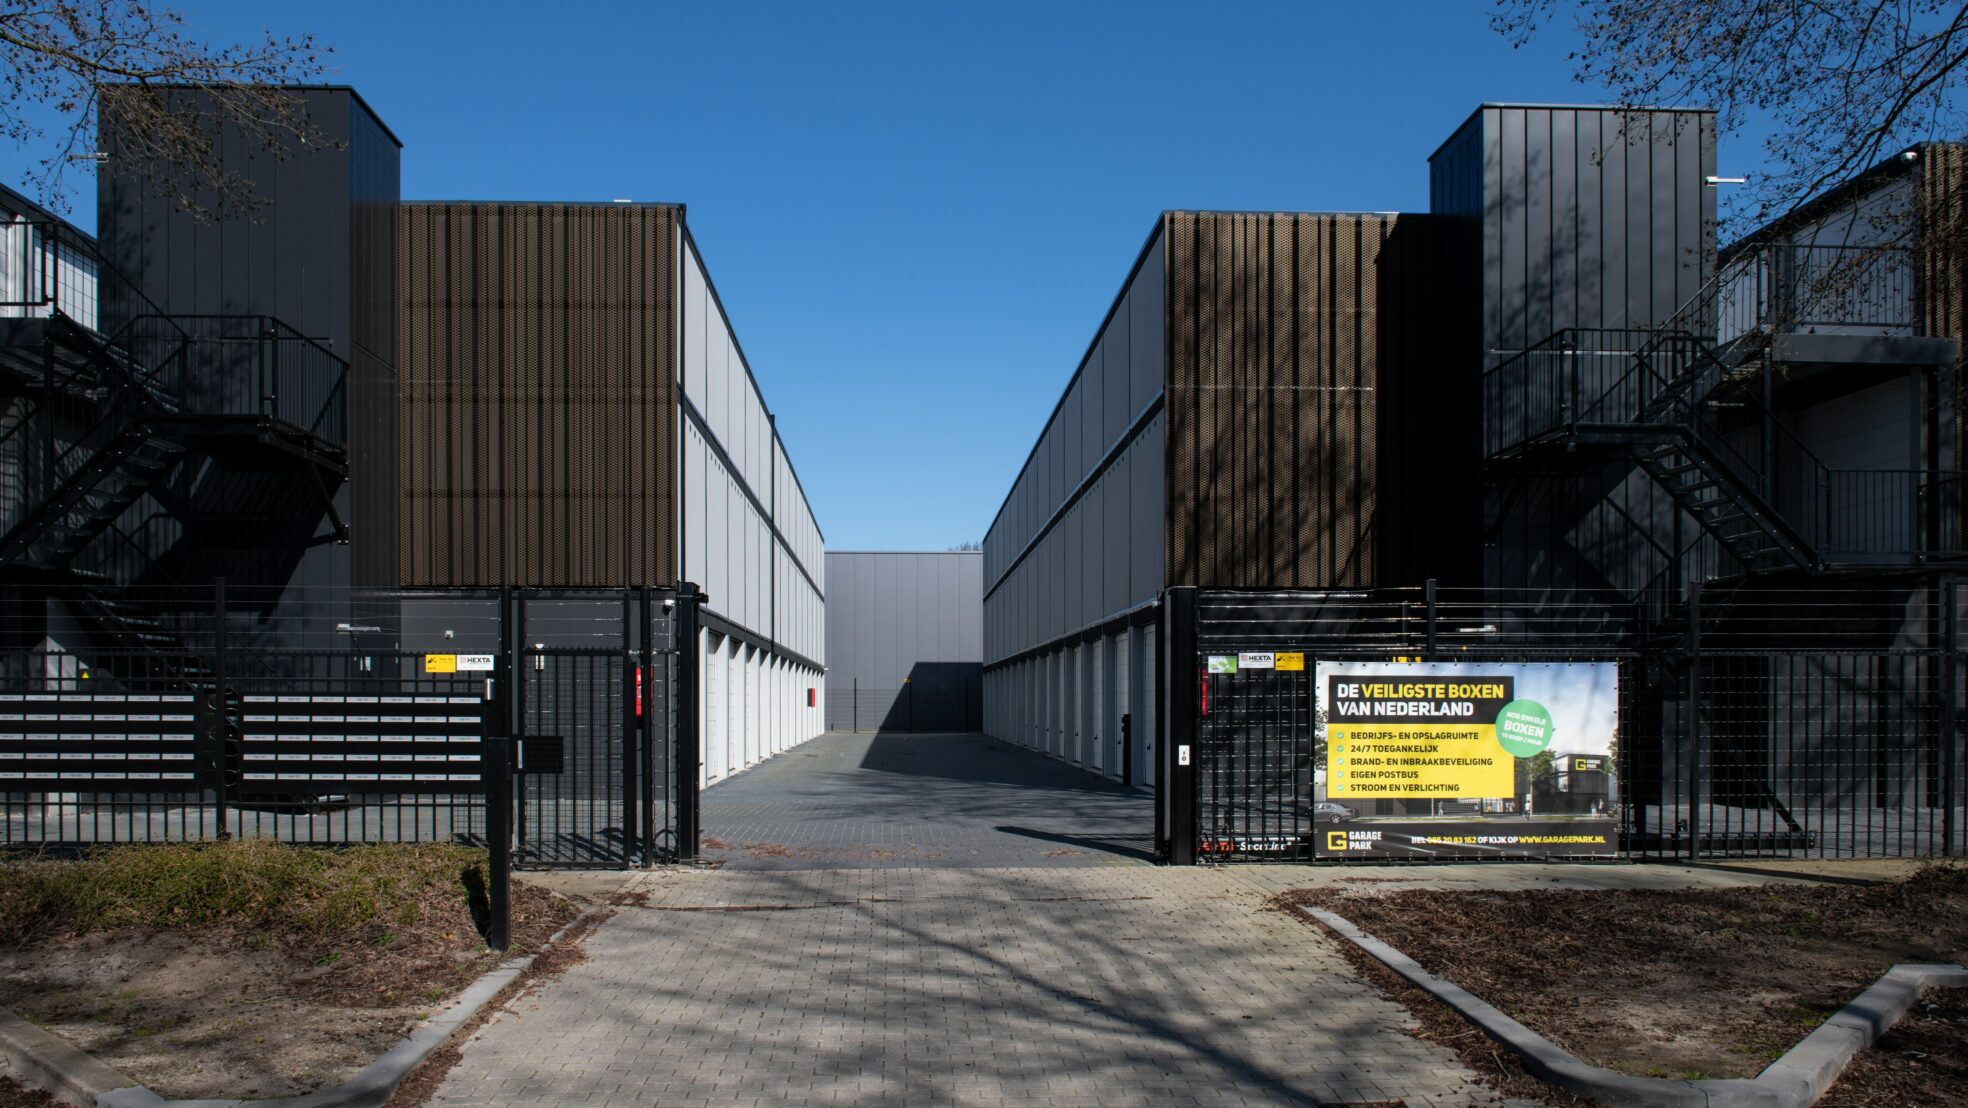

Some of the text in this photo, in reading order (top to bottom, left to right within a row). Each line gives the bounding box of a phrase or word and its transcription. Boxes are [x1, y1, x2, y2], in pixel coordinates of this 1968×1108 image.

[1337, 683, 1504, 699] DE VEILIGSTE BOXEN
[1337, 702, 1474, 716] VAN NEDERLAND
[1504, 720, 1545, 738] BOXEN
[1350, 732, 1479, 740] BEDRIJFS- EN OPSLAGRUIMTE
[1350, 745, 1438, 753] 24/7 TOEGANKELIJK
[1350, 758, 1493, 766] BRAND- EN INBRAAKBEVEILIGING
[1350, 784, 1460, 792] STROOM EN VERLICHTING
[1348, 831, 1382, 840] GARAGE
[1442, 836, 1453, 844] 20
[1464, 836, 1477, 844] 162
[1477, 836, 1488, 844] OF
[1488, 836, 1507, 844] KIJK
[1507, 836, 1519, 844] OP
[1519, 836, 1606, 844] WWW.GARAGEPARK.NL
[1349, 841, 1372, 850] PARK
